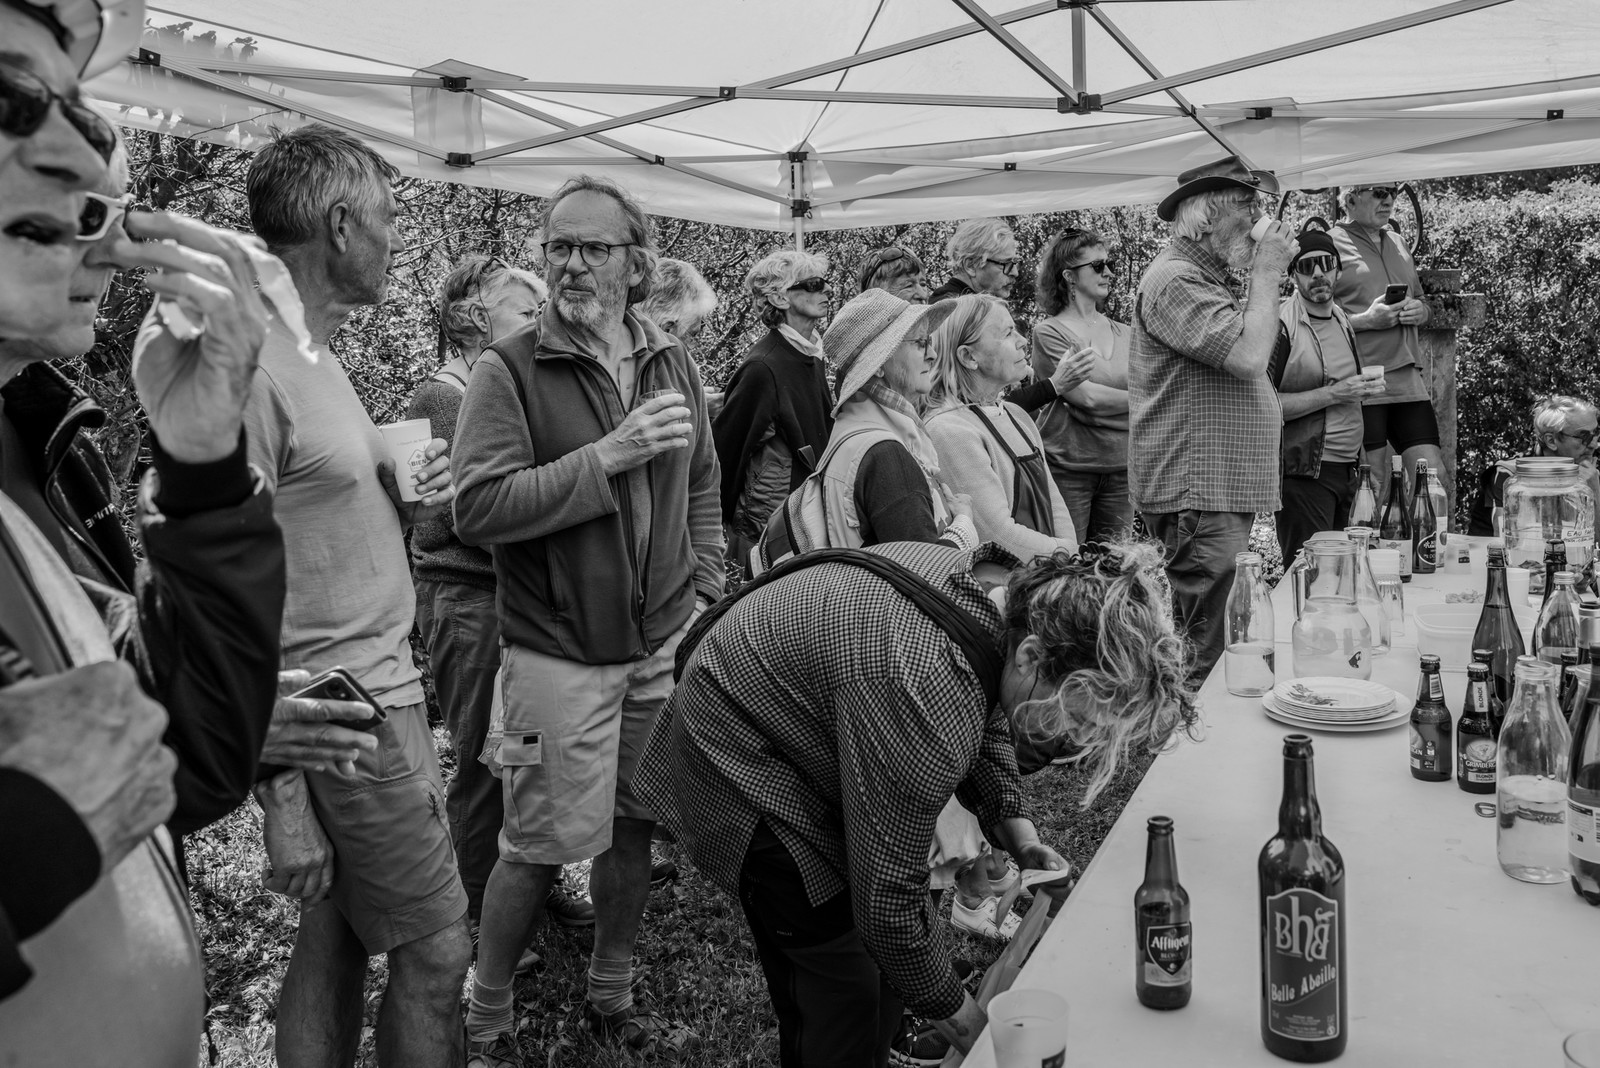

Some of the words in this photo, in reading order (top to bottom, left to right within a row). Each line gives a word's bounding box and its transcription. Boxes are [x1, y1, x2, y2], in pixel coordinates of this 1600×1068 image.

[411, 458, 427, 466] BIEN
[1271, 983, 1295, 1002] Belle
[1300, 964, 1336, 996] Abeille
